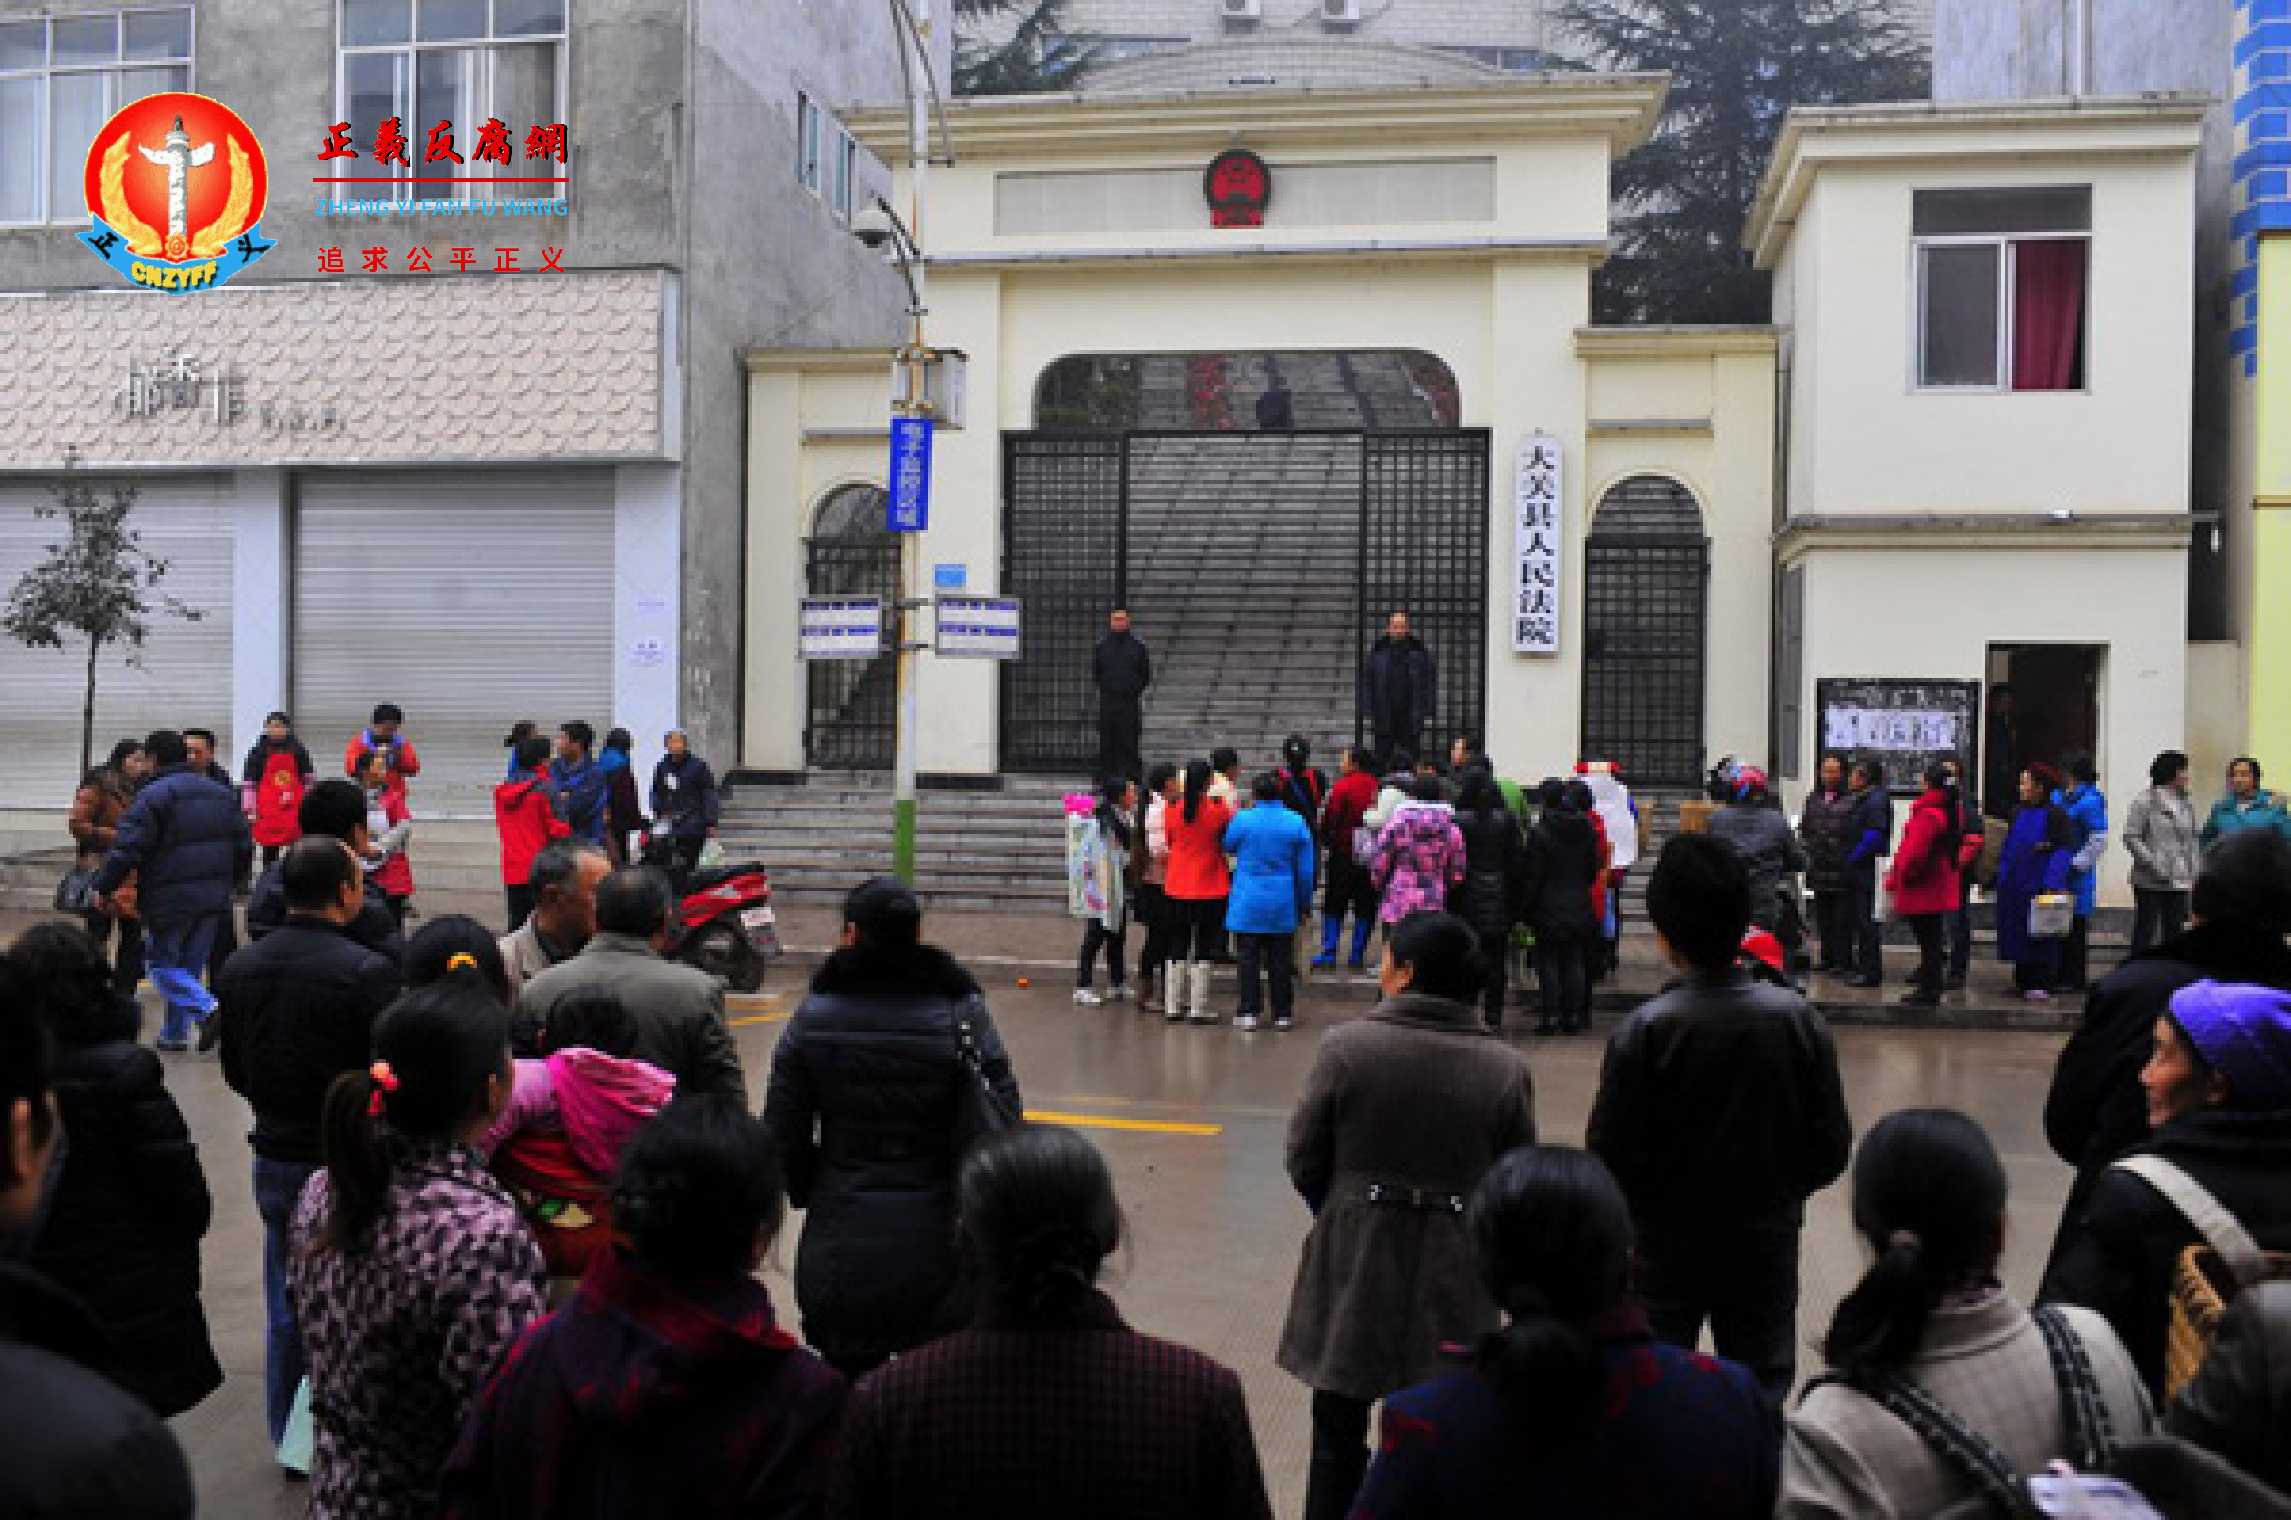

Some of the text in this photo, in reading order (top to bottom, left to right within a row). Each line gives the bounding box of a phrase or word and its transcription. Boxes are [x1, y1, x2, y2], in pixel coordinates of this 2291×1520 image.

[1517, 445, 1556, 645] 大关县人民法院
